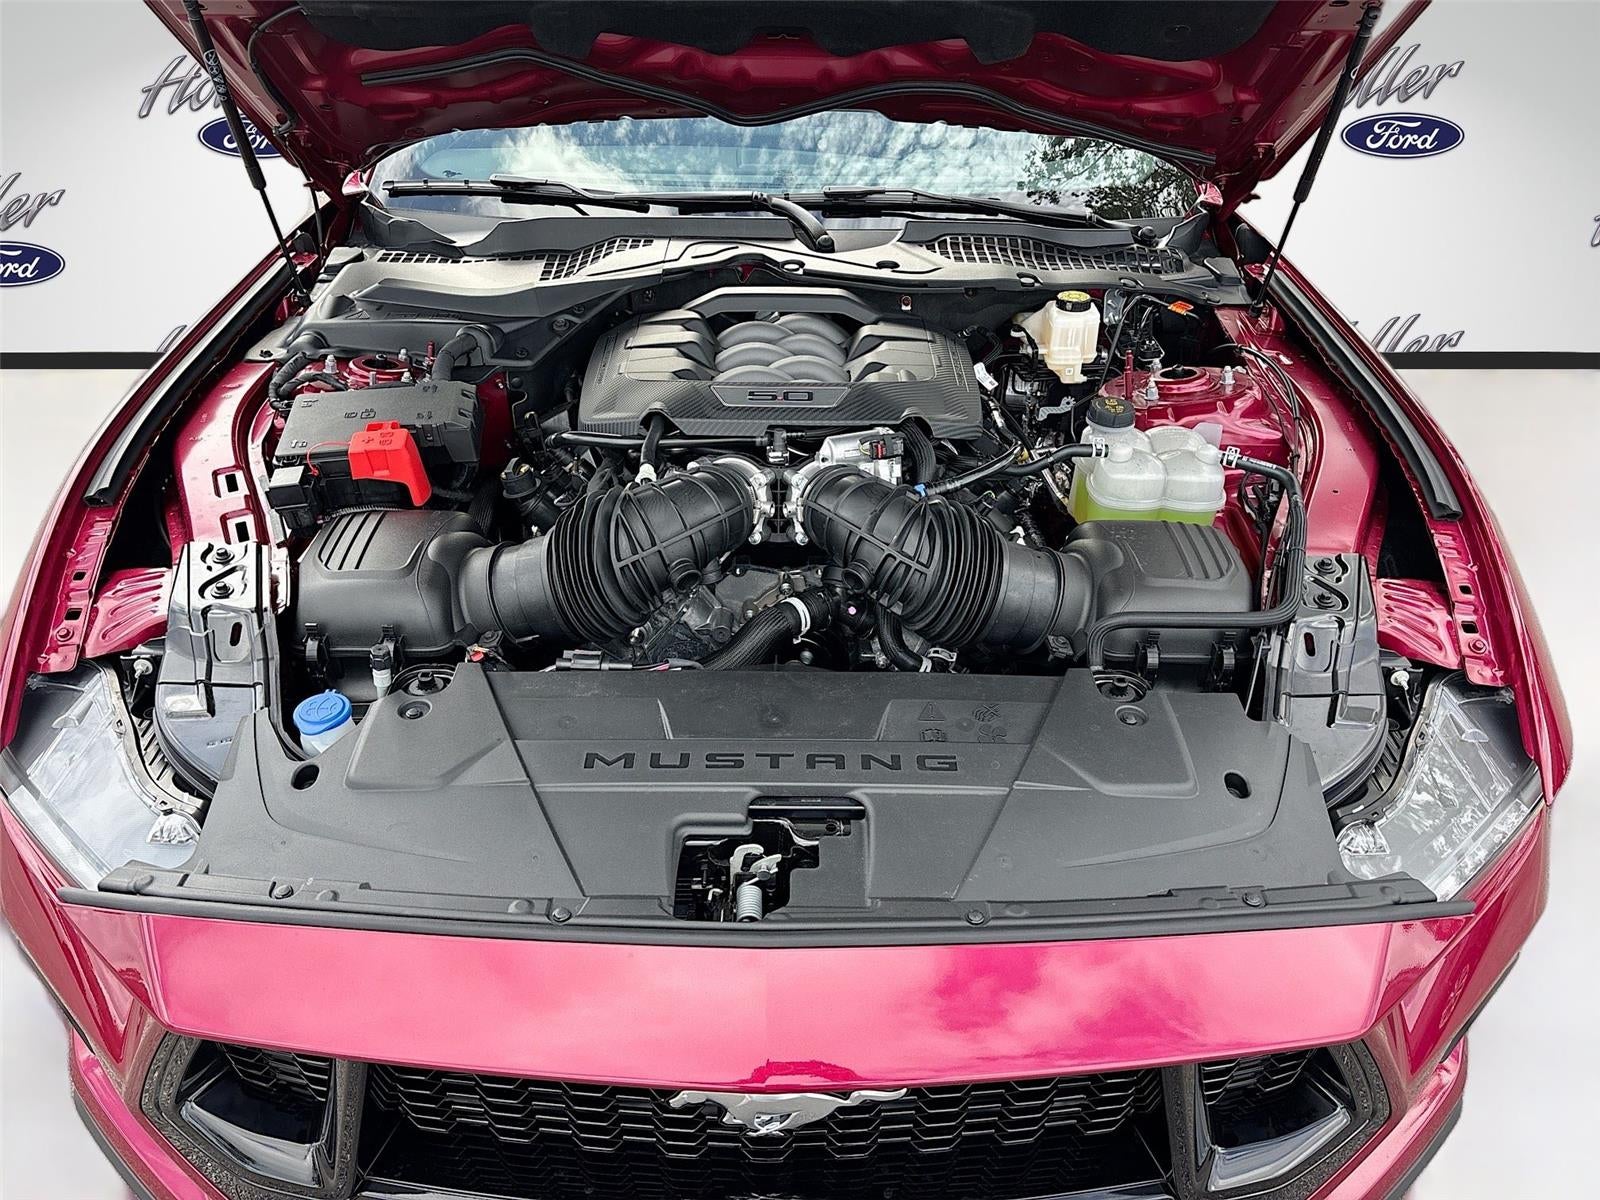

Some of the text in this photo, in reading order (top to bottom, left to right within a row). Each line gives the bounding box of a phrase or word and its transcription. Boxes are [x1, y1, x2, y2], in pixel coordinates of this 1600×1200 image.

[1343, 43, 1465, 110] ller
[1365, 119, 1441, 150] Ford
[0, 171, 66, 232] ler
[0, 249, 41, 278] rd
[583, 751, 959, 772] MUSTANG
